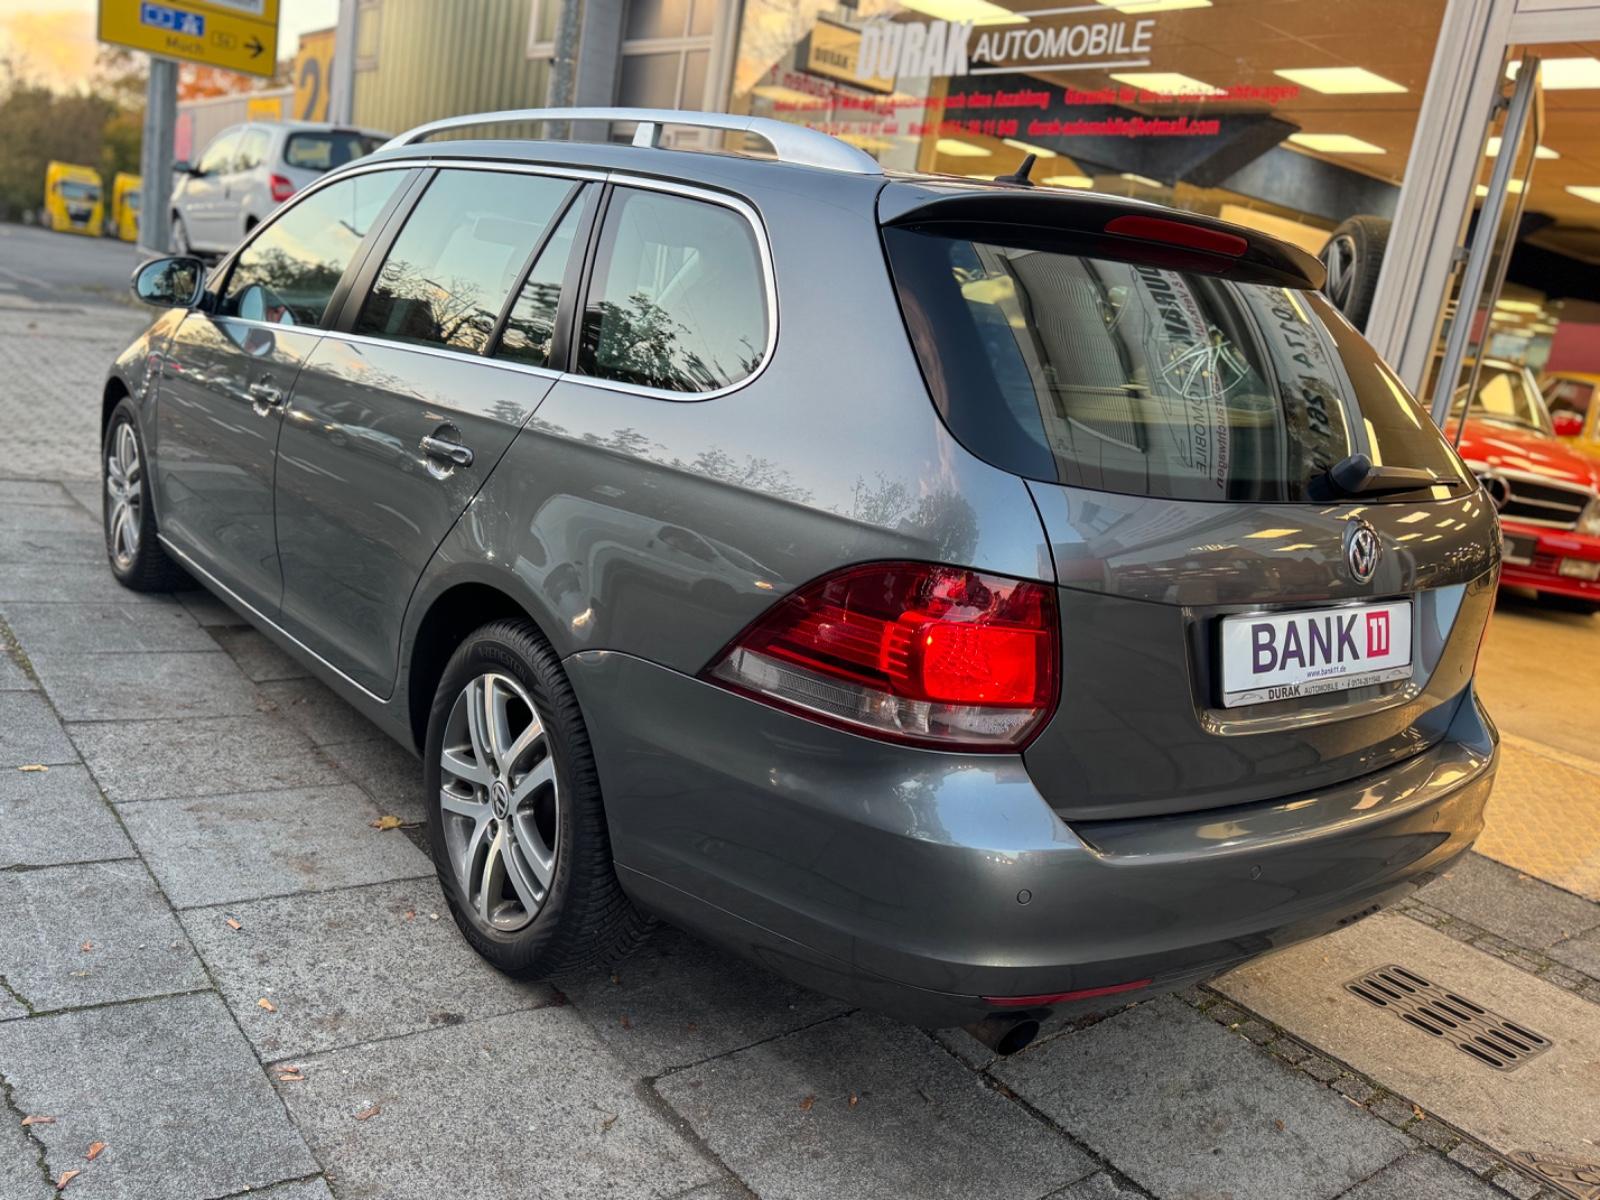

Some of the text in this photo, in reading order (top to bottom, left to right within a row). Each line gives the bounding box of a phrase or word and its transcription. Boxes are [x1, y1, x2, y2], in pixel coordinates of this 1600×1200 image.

[856, 20, 1155, 80] DURAK AUTOMOBILE
[1251, 613, 1388, 675] BANK 11
[1268, 685, 1301, 700] DURAK
[1304, 682, 1339, 695] AUTOMOBILE
[1306, 665, 1347, 679] www.bank11.de
